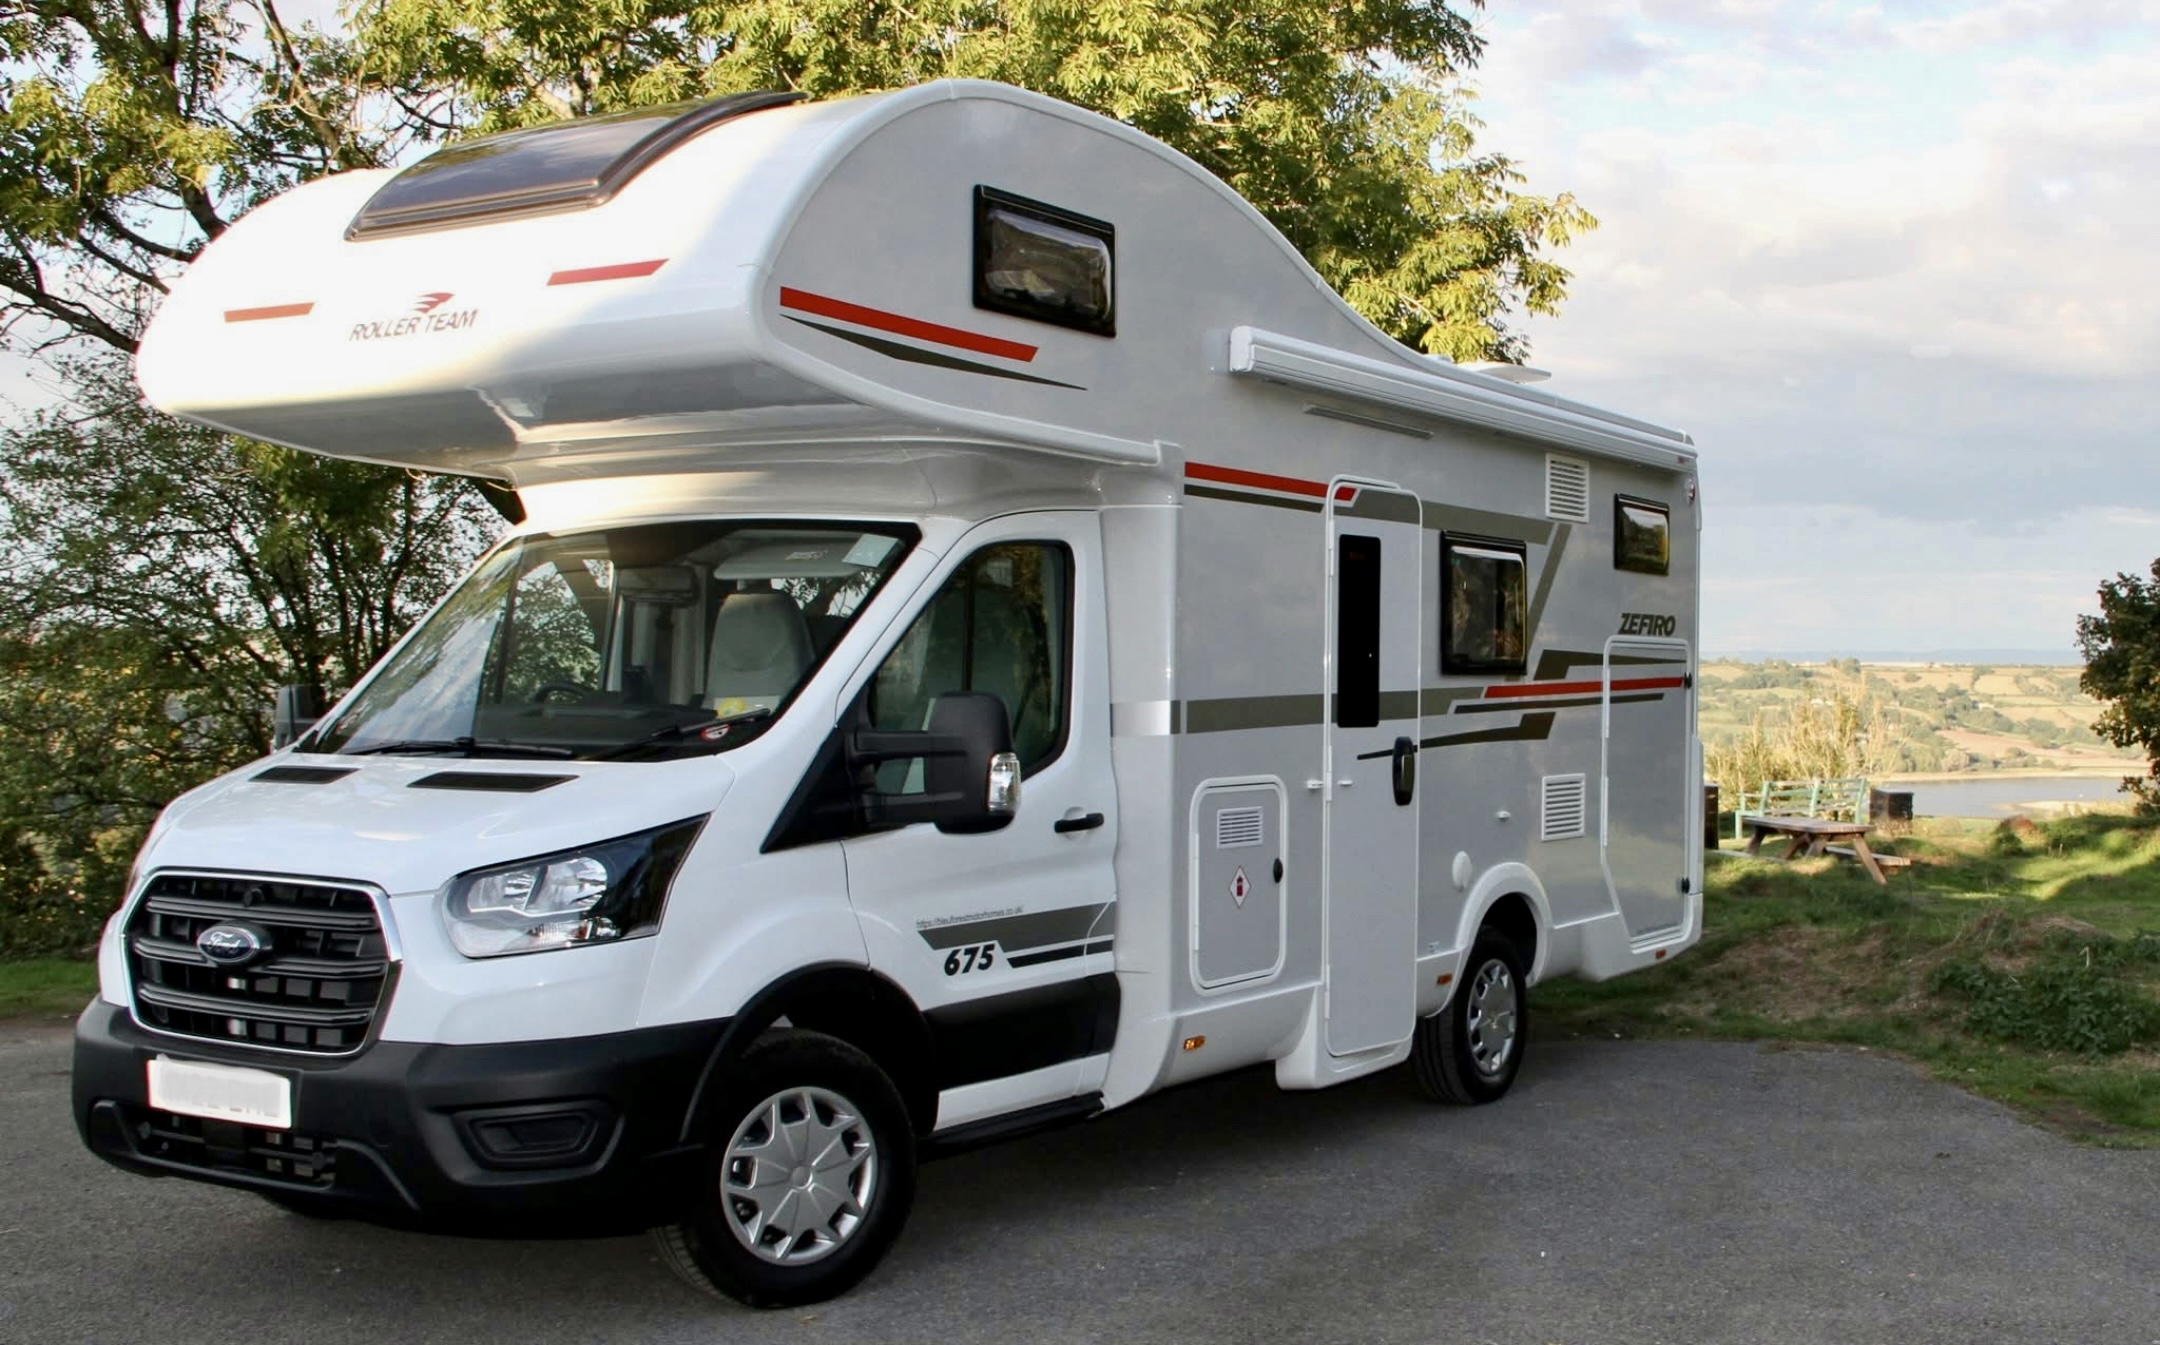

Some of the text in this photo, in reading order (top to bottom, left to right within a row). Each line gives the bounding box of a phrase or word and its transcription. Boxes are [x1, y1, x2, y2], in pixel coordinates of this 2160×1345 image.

[349, 309, 478, 341] ROLLER TEAM
[1618, 612, 1676, 637] ZEFIRO
[205, 931, 242, 953] Ford
[944, 943, 996, 977] 675
